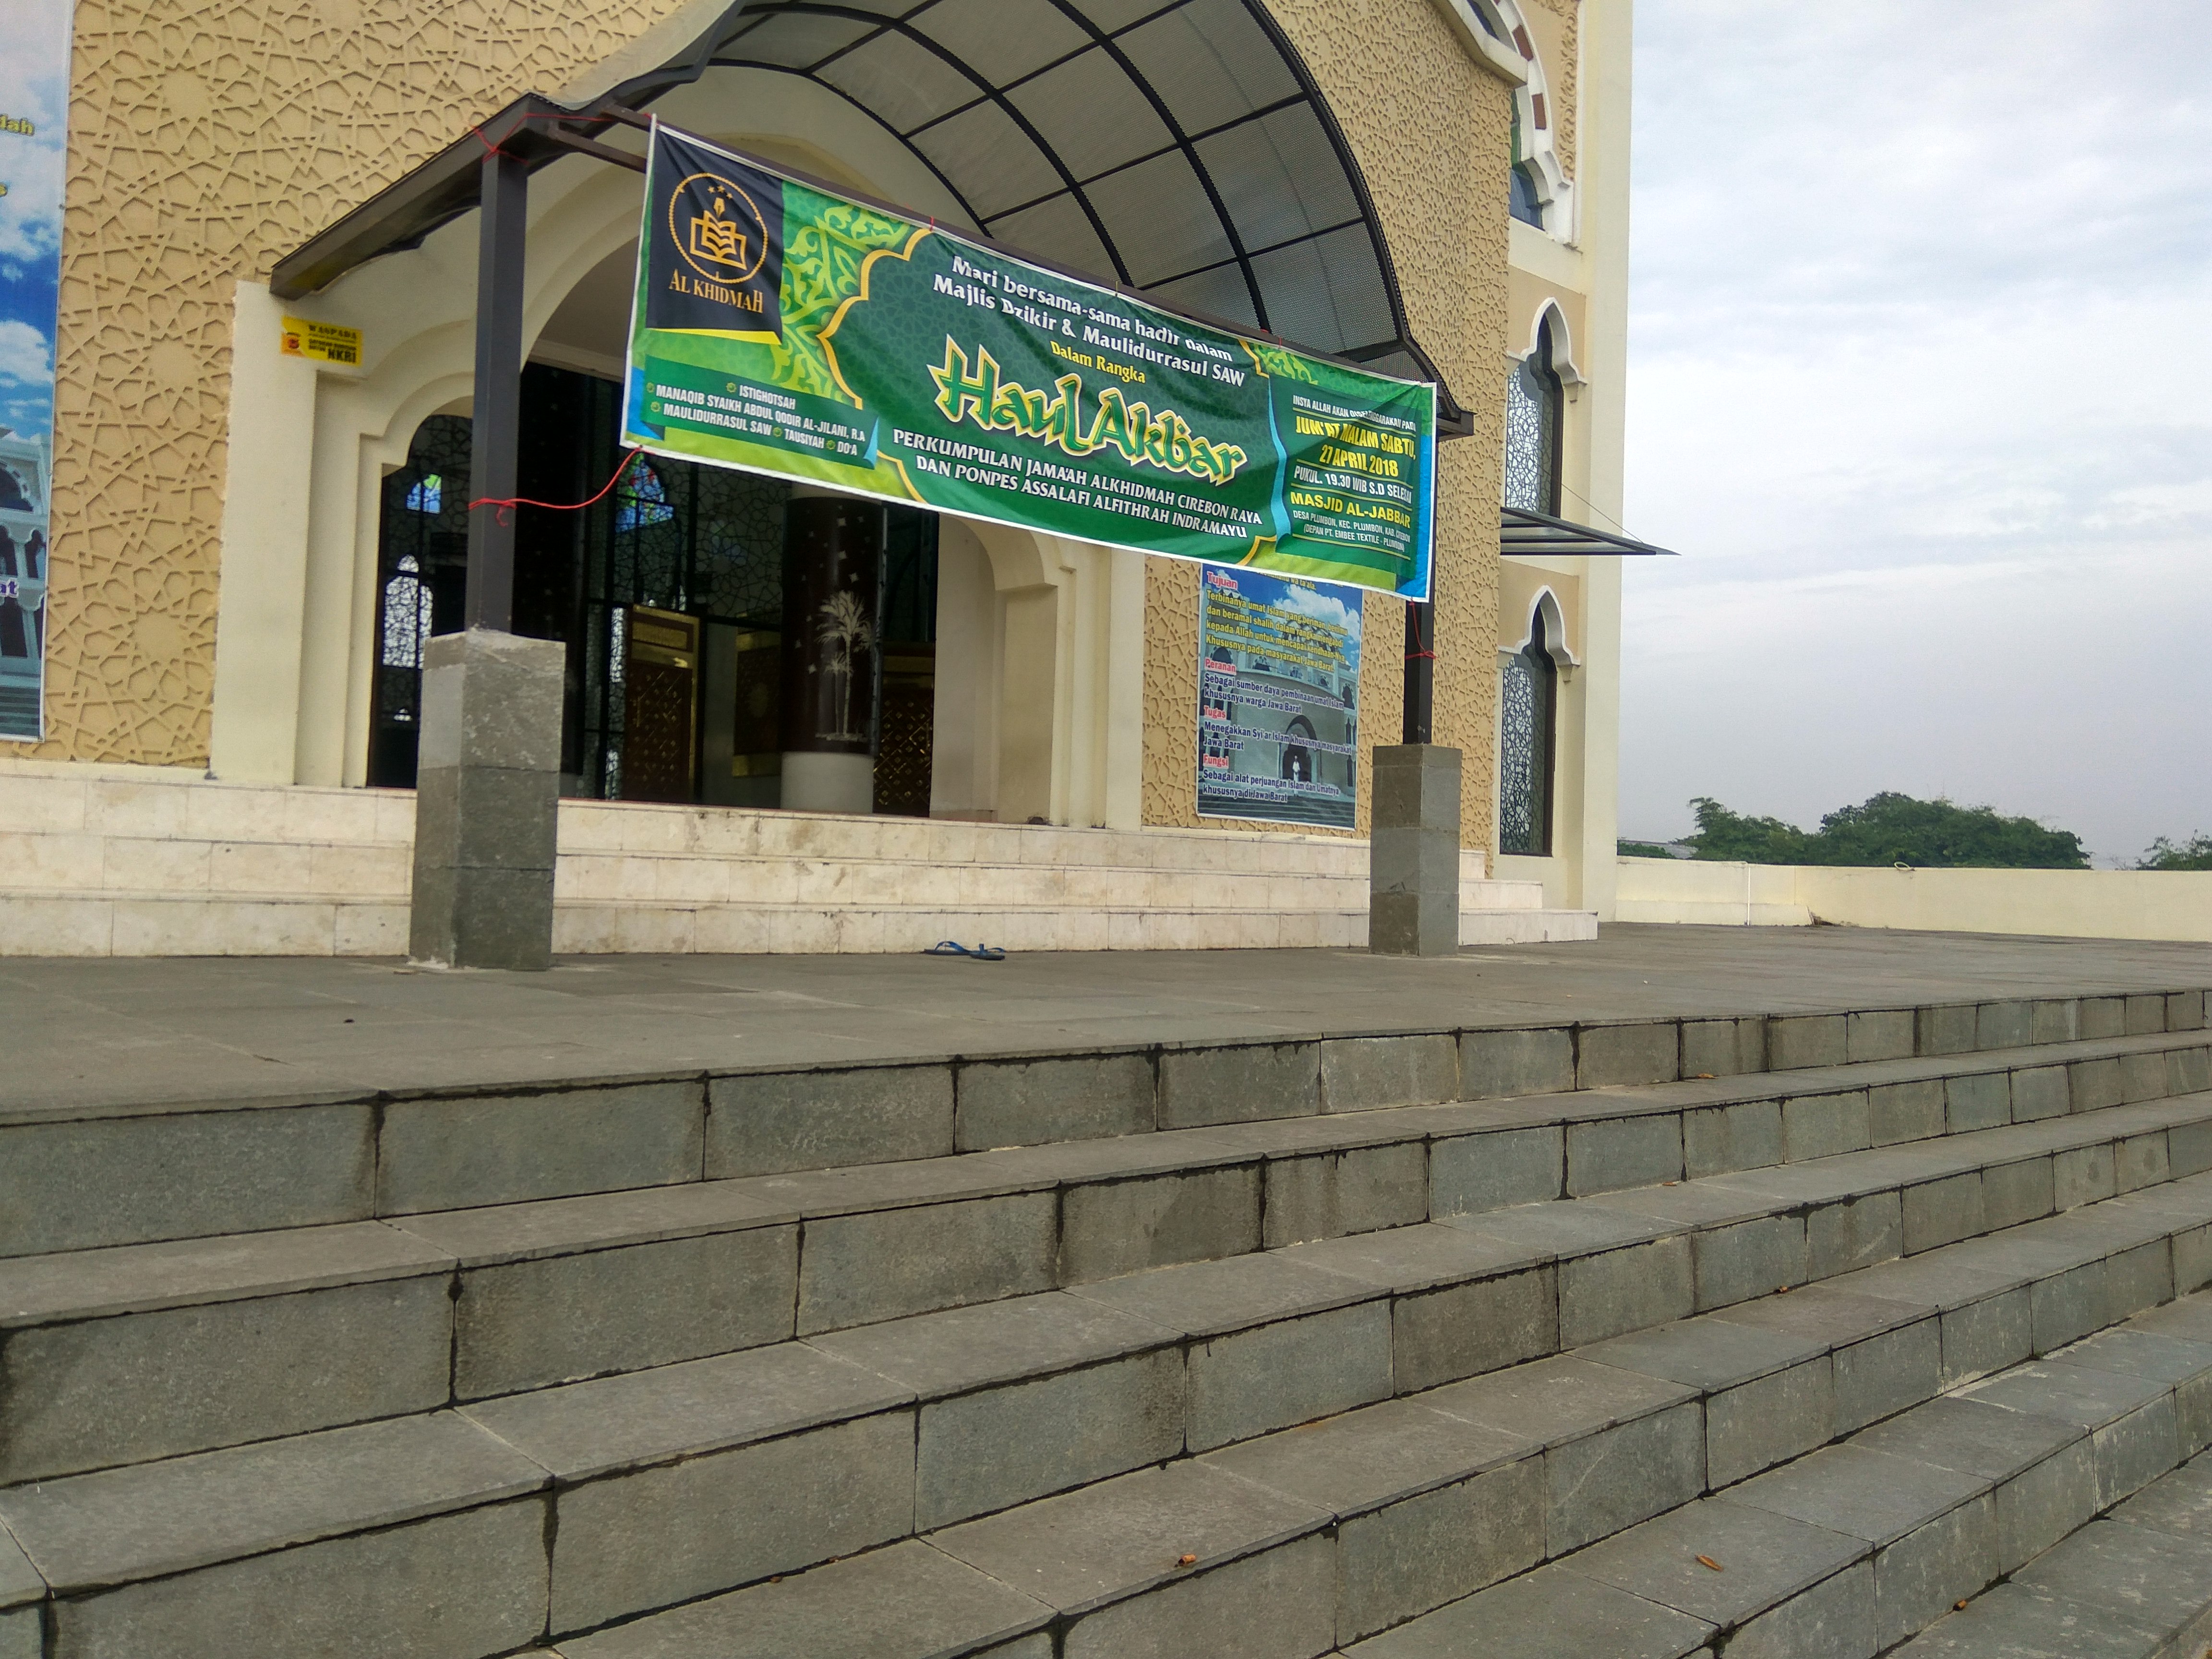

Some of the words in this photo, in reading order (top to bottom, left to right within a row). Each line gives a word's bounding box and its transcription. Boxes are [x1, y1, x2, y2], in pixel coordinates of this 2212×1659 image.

[669, 268, 690, 293] AL
[693, 279, 763, 313] KHIDMAH
[952, 255, 998, 288] Mari
[1003, 275, 1130, 332] bersama-sama
[1135, 319, 1180, 346] hadir
[1185, 338, 1233, 362] dalam
[933, 274, 996, 309] Majlis
[1001, 298, 1057, 331] Dzikir
[1061, 318, 1077, 338] &
[1082, 325, 1208, 376] Maulidurrasul
[1212, 363, 1245, 387] SAW
[1050, 340, 1093, 368] Dalam
[1095, 355, 1146, 384] Rangka
[656, 385, 705, 405] MANAQIB
[707, 395, 742, 413] SYAIKH
[743, 402, 773, 420] ABDUL
[775, 410, 802, 428] QODIR
[803, 418, 850, 439] AL-JILANI,
[851, 428, 866, 442] R.A
[739, 385, 796, 410] ISTIGHOTSAH
[927, 334, 1096, 456] Haul
[1090, 387, 1247, 485] Akbar
[1293, 395, 1311, 408] INSYA
[1312, 400, 1331, 414] ALLAH
[1332, 405, 1349, 417] AKAN
[663, 403, 748, 431] MAULIDURRASUL
[750, 421, 772, 436] SAW
[784, 428, 825, 449] TAUSIYAH
[837, 441, 857, 456] DO'A
[1296, 416, 1340, 438] JUM'AT
[1340, 423, 1379, 449] MALAM
[1381, 433, 1416, 460] SABTU,
[893, 429, 1022, 472] PERKUMPULAN
[1025, 459, 1088, 486] JAMA'AH
[1090, 474, 1175, 506] ALKHIDMAH
[1177, 494, 1230, 519] CIREBON
[1229, 506, 1263, 525] RAYA
[1319, 445, 1334, 464] 27
[1332, 448, 1368, 471] APRIL
[1369, 455, 1399, 477] 2018
[916, 455, 952, 478] DAN
[954, 464, 1018, 491] PONPES
[1021, 479, 1091, 506] ASSALAFI
[1093, 494, 1170, 524] ALFITHRAH
[1171, 512, 1248, 538] INDRAMAYU
[1294, 465, 1323, 484] PUKUL.
[1325, 473, 1351, 489] 19.30
[1352, 477, 1367, 493] WIB
[1369, 481, 1385, 495] S.D
[1387, 485, 1412, 504] SELESAI
[1290, 492, 1343, 513] MASJID
[1346, 502, 1410, 529] AL-JABBAR
[1293, 510, 1310, 520] DESA
[1310, 513, 1338, 528] PLUMBON,
[1339, 520, 1352, 530] KEC.
[1354, 523, 1383, 535] PLUMBON,
[1385, 527, 1395, 538] KAB.
[1304, 523, 1324, 536] (DEPAN
[1324, 529, 1334, 538] PT.
[1335, 530, 1356, 541] EMBEE
[1356, 533, 1380, 544] TEXTILE
[1207, 571, 1238, 589] Tujuan
[1207, 590, 1247, 608] Terbinanya
[1249, 601, 1266, 613] umat
[1267, 604, 1286, 618] Islam
[1286, 610, 1302, 623] yang
[1207, 606, 1221, 616] dan
[1222, 608, 1252, 623] beramal
[1253, 616, 1274, 629] shalih
[1275, 622, 1296, 635] dalam
[1206, 620, 1235, 635] kepada
[1235, 625, 1253, 638] Allah
[1255, 631, 1274, 643] untuk
[1275, 637, 1307, 653] mencapai
[1206, 634, 1245, 650] Khususnya
[1248, 644, 1264, 656] pada
[1266, 648, 1304, 664] masyarakat
[1304, 658, 1318, 668] Jawa
[1205, 659, 1236, 673] Peranan
[1204, 688, 1244, 703] khususnya
[1246, 697, 1266, 708] warga
[1268, 699, 1283, 710] Jawa
[1285, 702, 1302, 713] Barat
[1205, 673, 1235, 688] Sebagai
[1237, 681, 1263, 693] sumber
[1264, 684, 1280, 697] daya
[1281, 689, 1314, 703] pembinaan
[1315, 697, 1329, 707] umat
[1329, 699, 1344, 709] Islam
[1204, 706, 1226, 719] Tugas
[1204, 721, 1251, 737] Menegakkan
[1273, 731, 1290, 743] Islam
[1290, 736, 1321, 750] khususnya
[1321, 743, 1352, 755] masyarakat
[1204, 736, 1222, 747] Jawa
[1224, 740, 1244, 750] Barat
[1203, 755, 1228, 767] Fungsi
[1203, 769, 1233, 782] Sebagai
[1235, 772, 1249, 783] alat
[1250, 776, 1287, 789] perjuangan
[1288, 781, 1304, 790] Islam
[1305, 782, 1316, 791] dan
[1317, 784, 1339, 797] Umatnya
[1203, 785, 1243, 798] khususnya
[1252, 791, 1269, 799] Jawa
[1270, 792, 1288, 802] Barat
